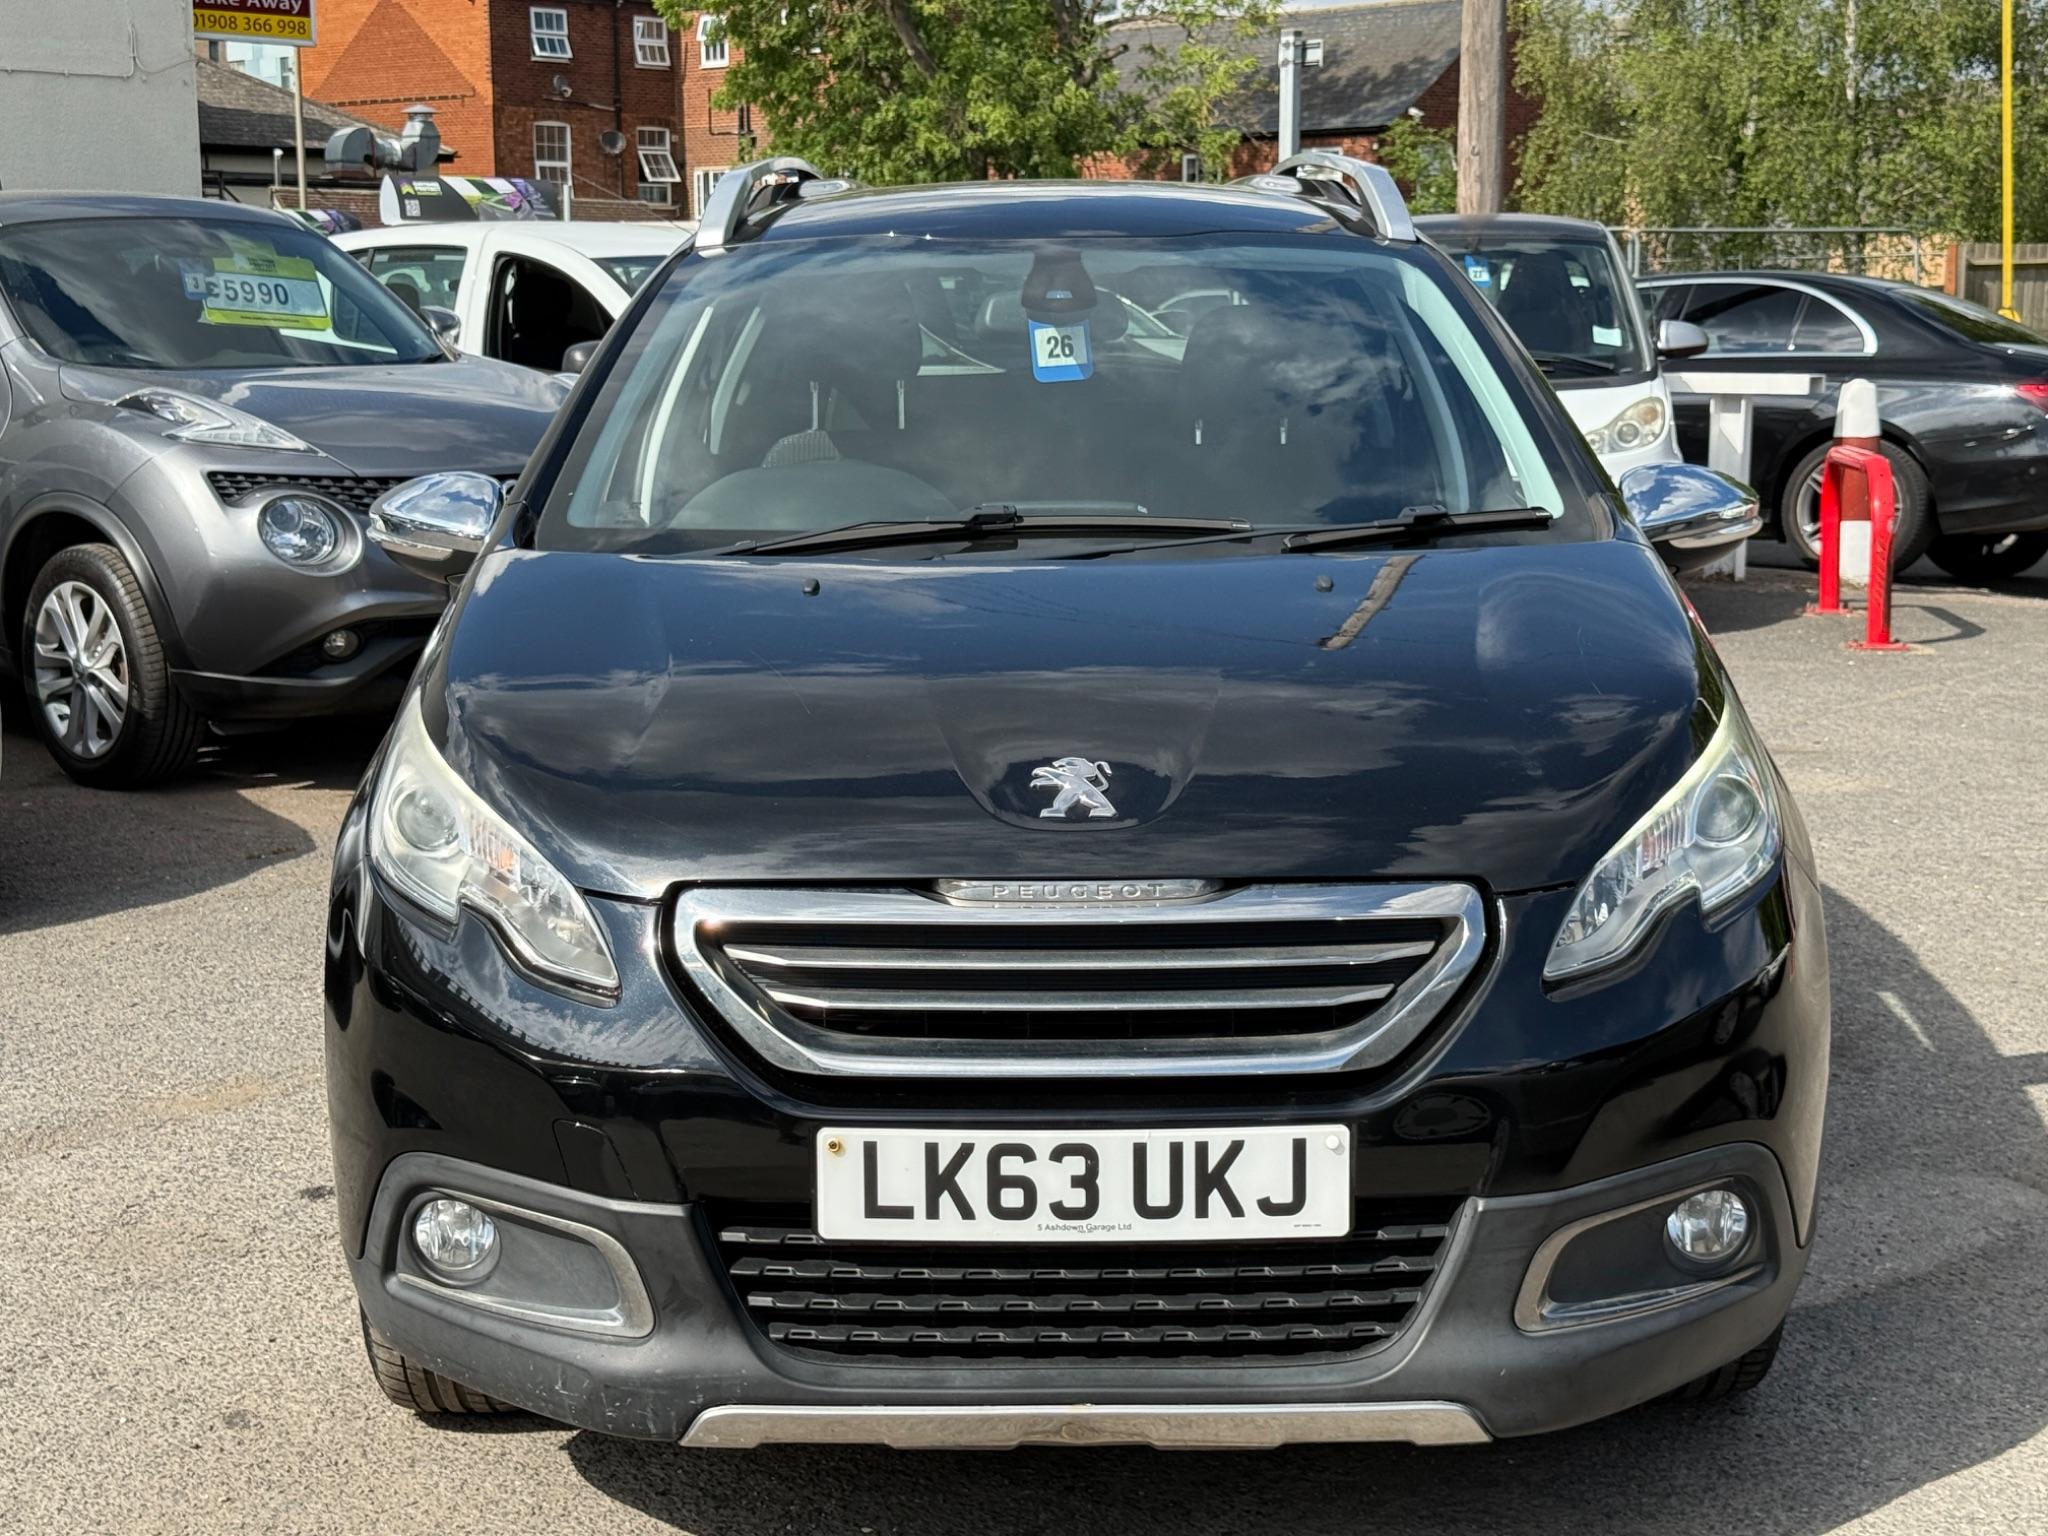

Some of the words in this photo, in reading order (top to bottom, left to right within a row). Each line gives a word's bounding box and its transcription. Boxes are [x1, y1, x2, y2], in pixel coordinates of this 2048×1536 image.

[246, 0, 301, 14] Away
[242, 17, 273, 32] 366
[277, 20, 307, 35] 998
[205, 278, 289, 306] £5990
[1046, 334, 1075, 359] 26
[991, 883, 1165, 900] PEUGEOT
[863, 1140, 1101, 1221] LK63
[1132, 1137, 1308, 1220] UKJ
[1044, 1223, 1084, 1232] Ashdown
[1085, 1223, 1117, 1232] Garage
[1117, 1223, 1132, 1231] Ltd
